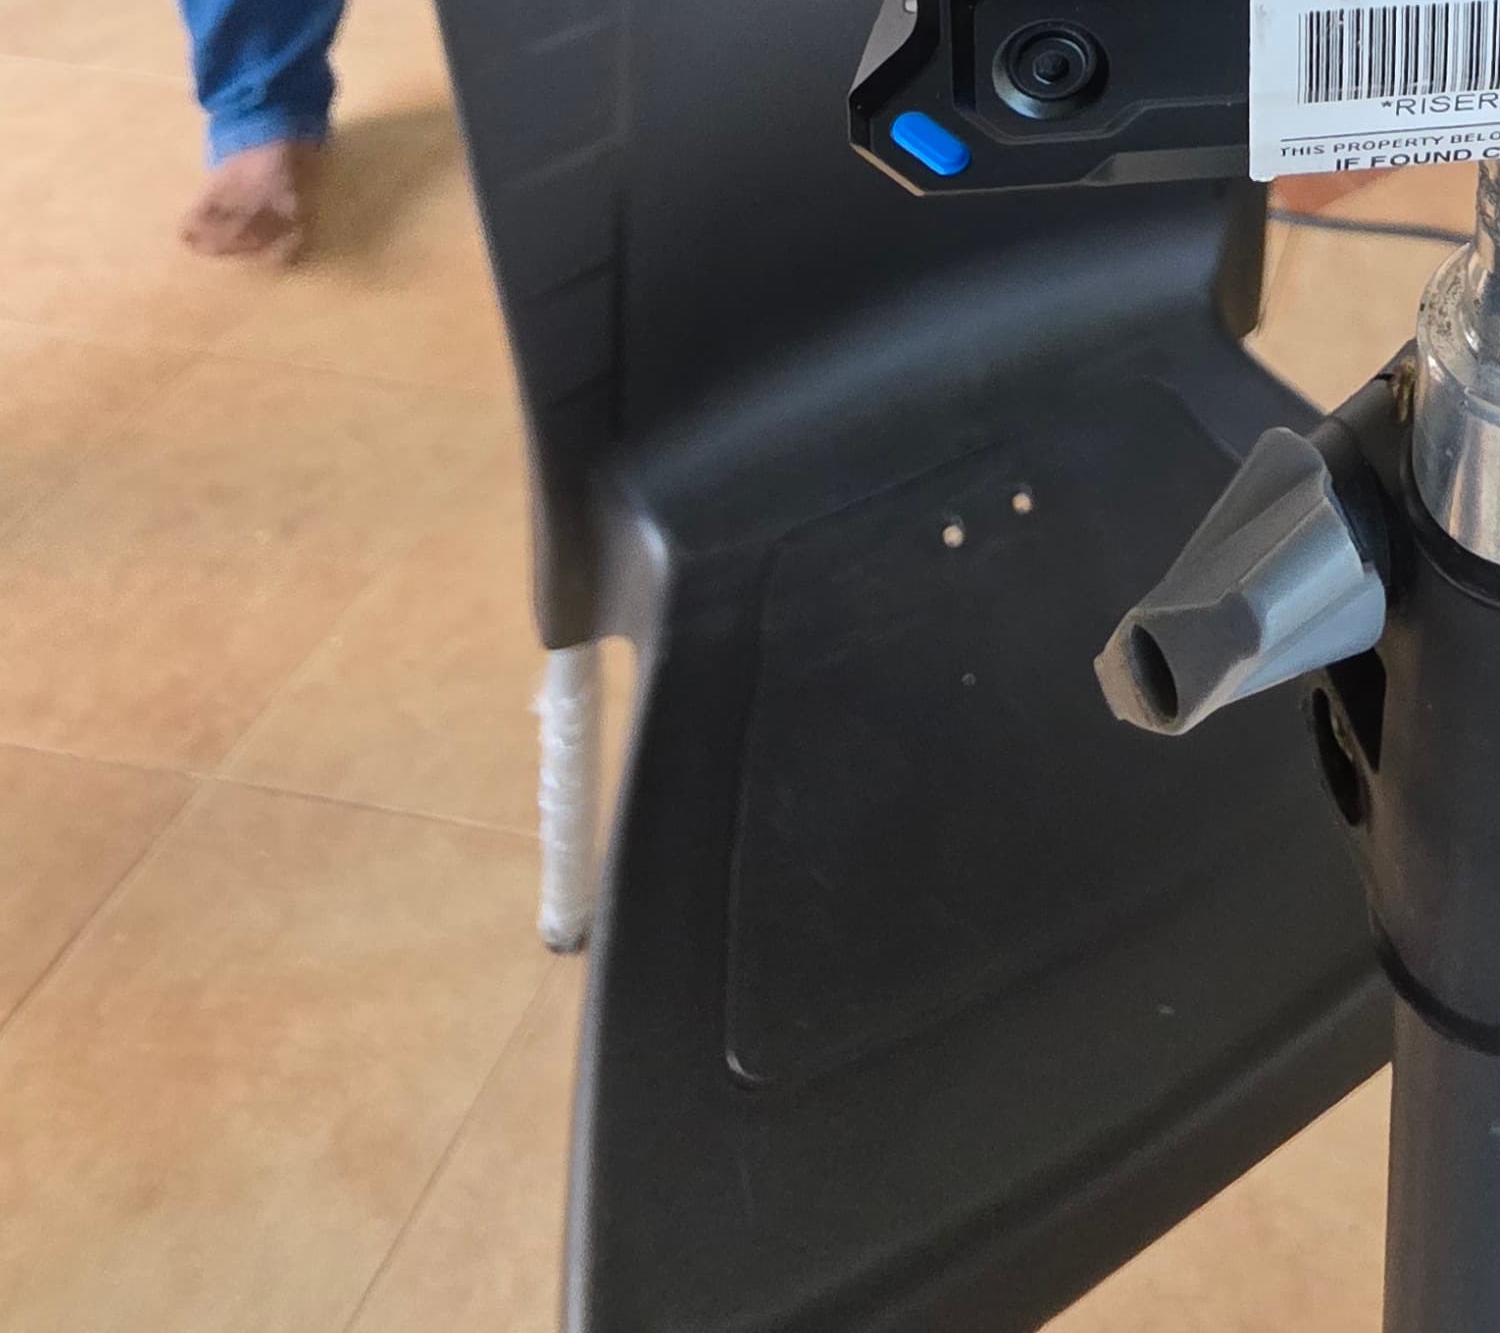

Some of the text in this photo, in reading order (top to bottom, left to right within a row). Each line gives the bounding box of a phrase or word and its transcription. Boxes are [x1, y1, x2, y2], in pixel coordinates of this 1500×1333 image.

[1280, 145, 1325, 157] THIS
[1334, 136, 1444, 153] PROPERTY
[1335, 157, 1361, 171] IF
[1370, 148, 1473, 168] FOUND
